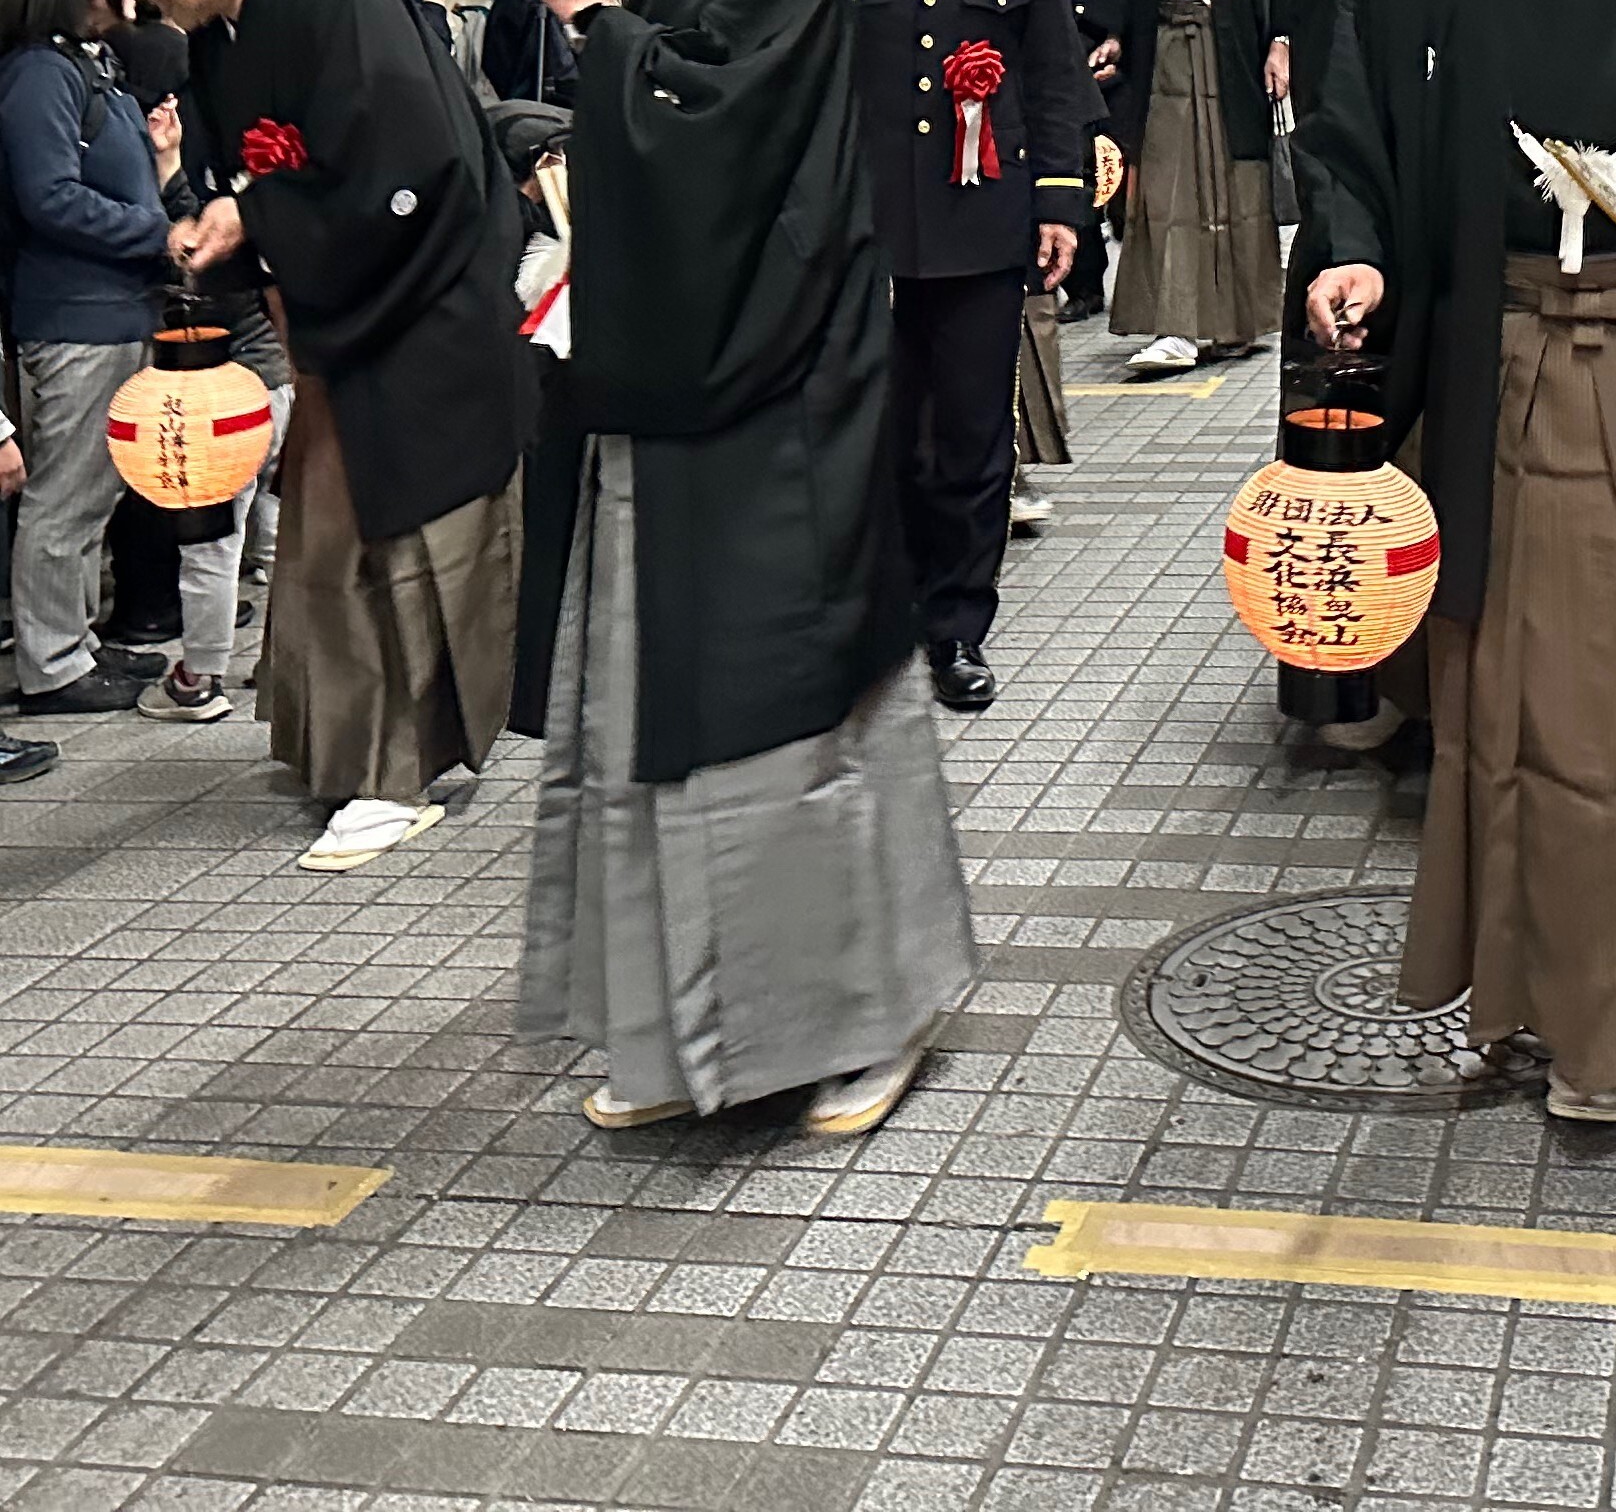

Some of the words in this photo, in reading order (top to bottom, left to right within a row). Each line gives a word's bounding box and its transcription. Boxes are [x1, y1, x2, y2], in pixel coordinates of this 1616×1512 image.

[1249, 489, 1394, 527] 財団法人
[1310, 530, 1367, 646] 長浜曳山
